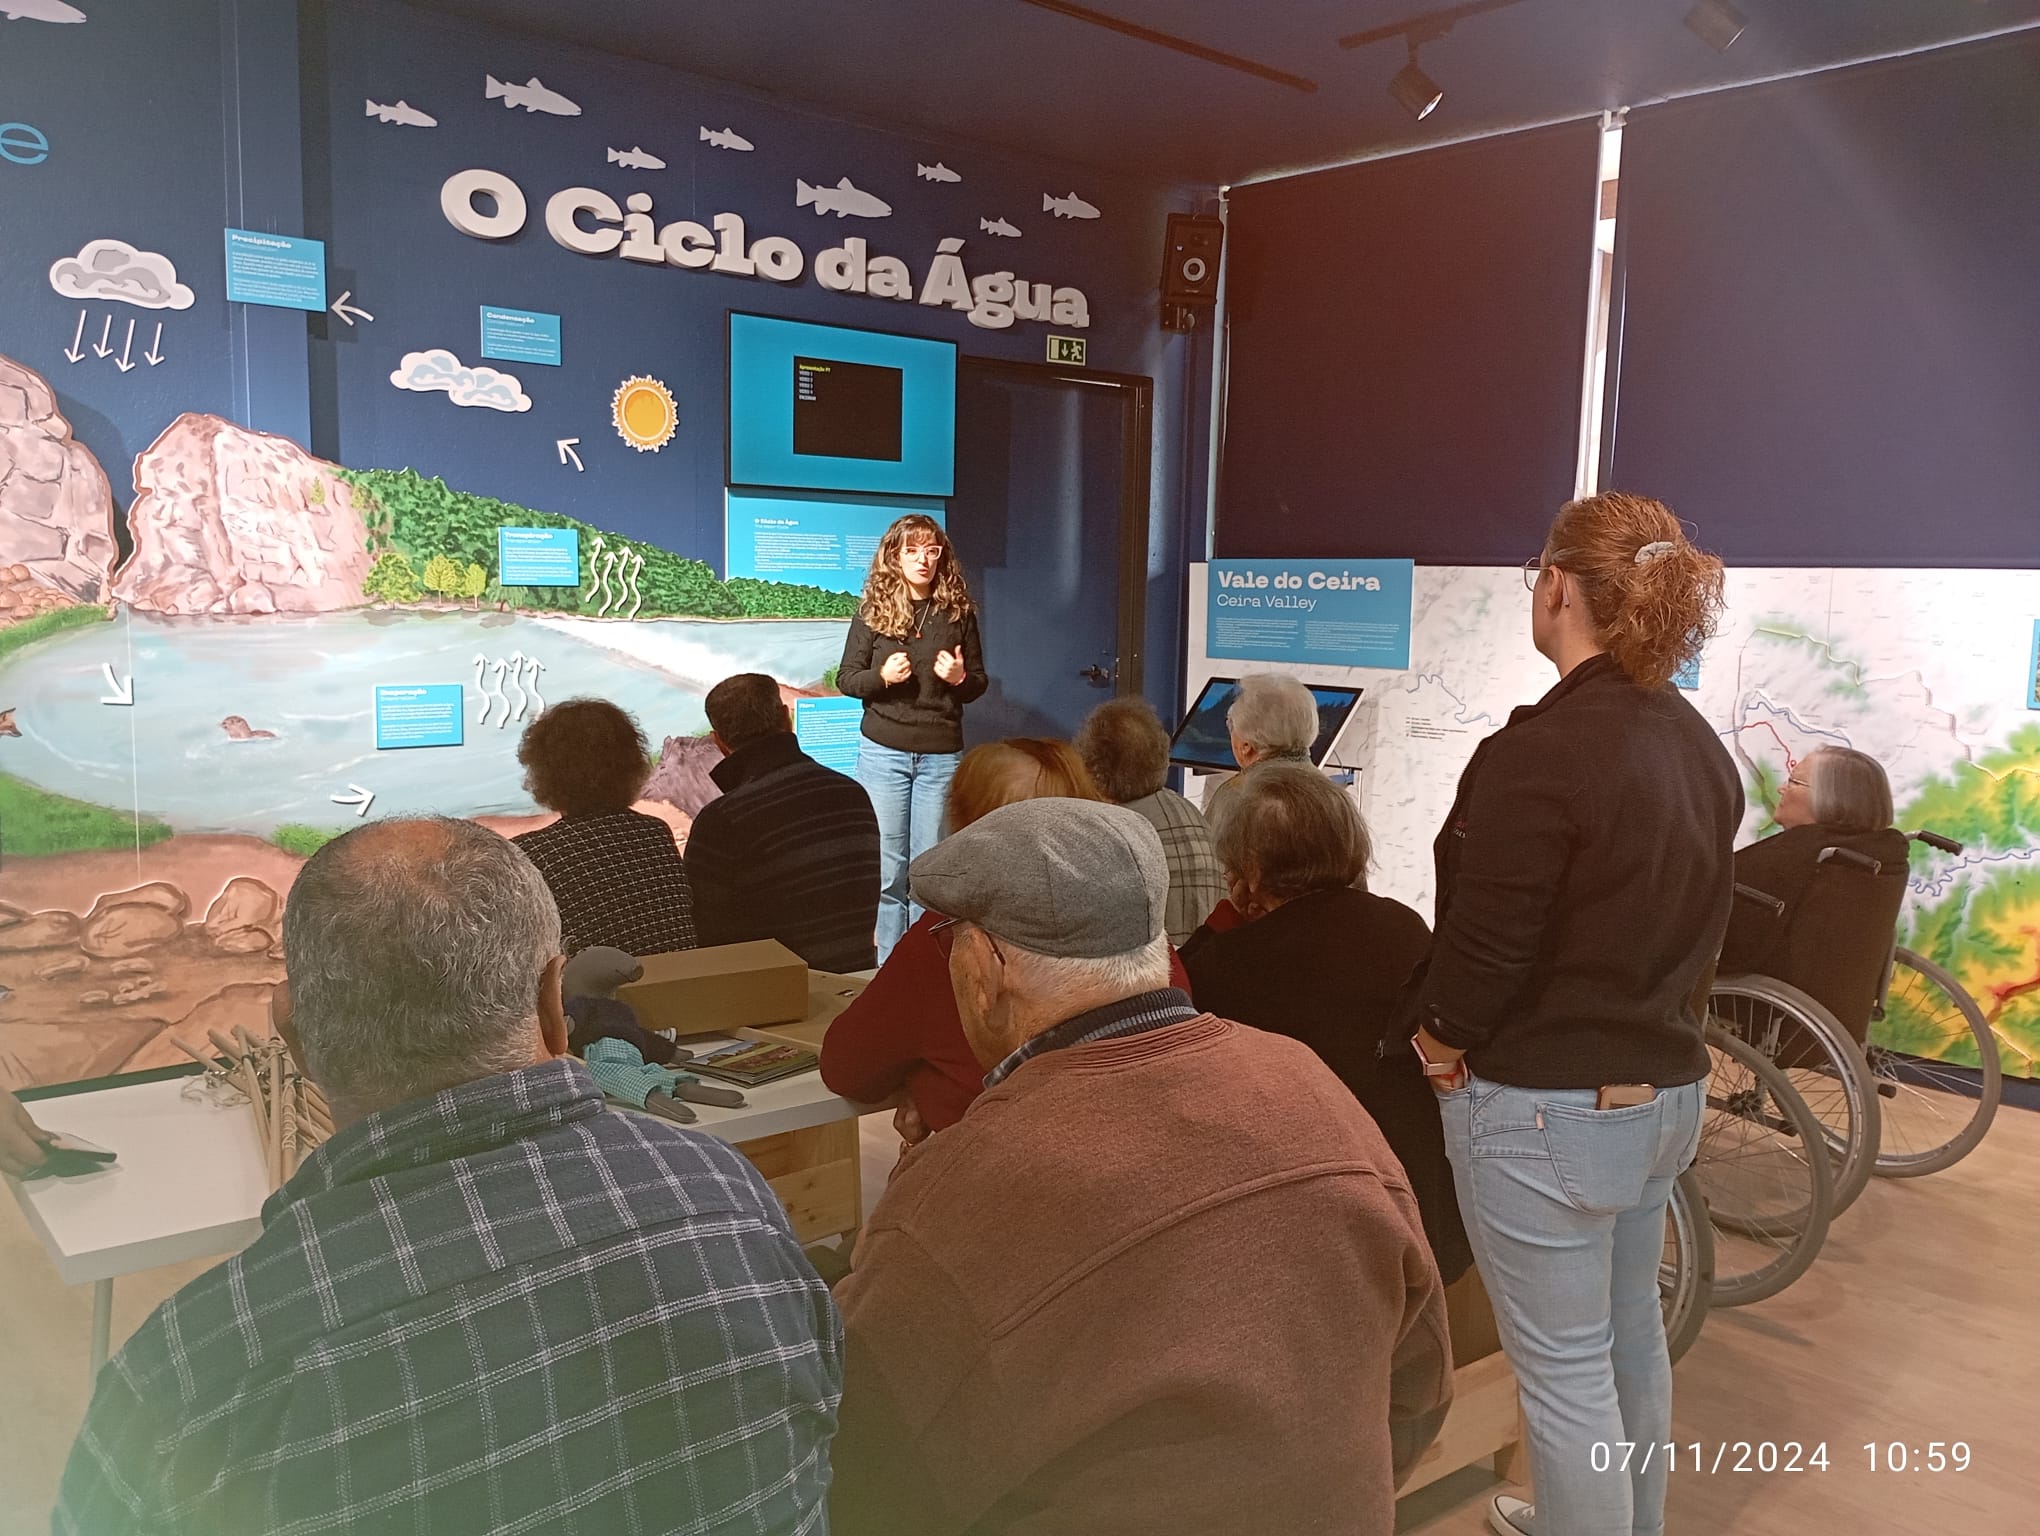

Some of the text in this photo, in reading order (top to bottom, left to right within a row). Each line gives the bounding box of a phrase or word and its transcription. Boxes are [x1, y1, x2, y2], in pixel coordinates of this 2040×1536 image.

[441, 169, 1090, 329] O Ciclo da Água
[1217, 571, 1381, 591] Vale do Ceira
[1216, 593, 1318, 613] Ceira Valley
